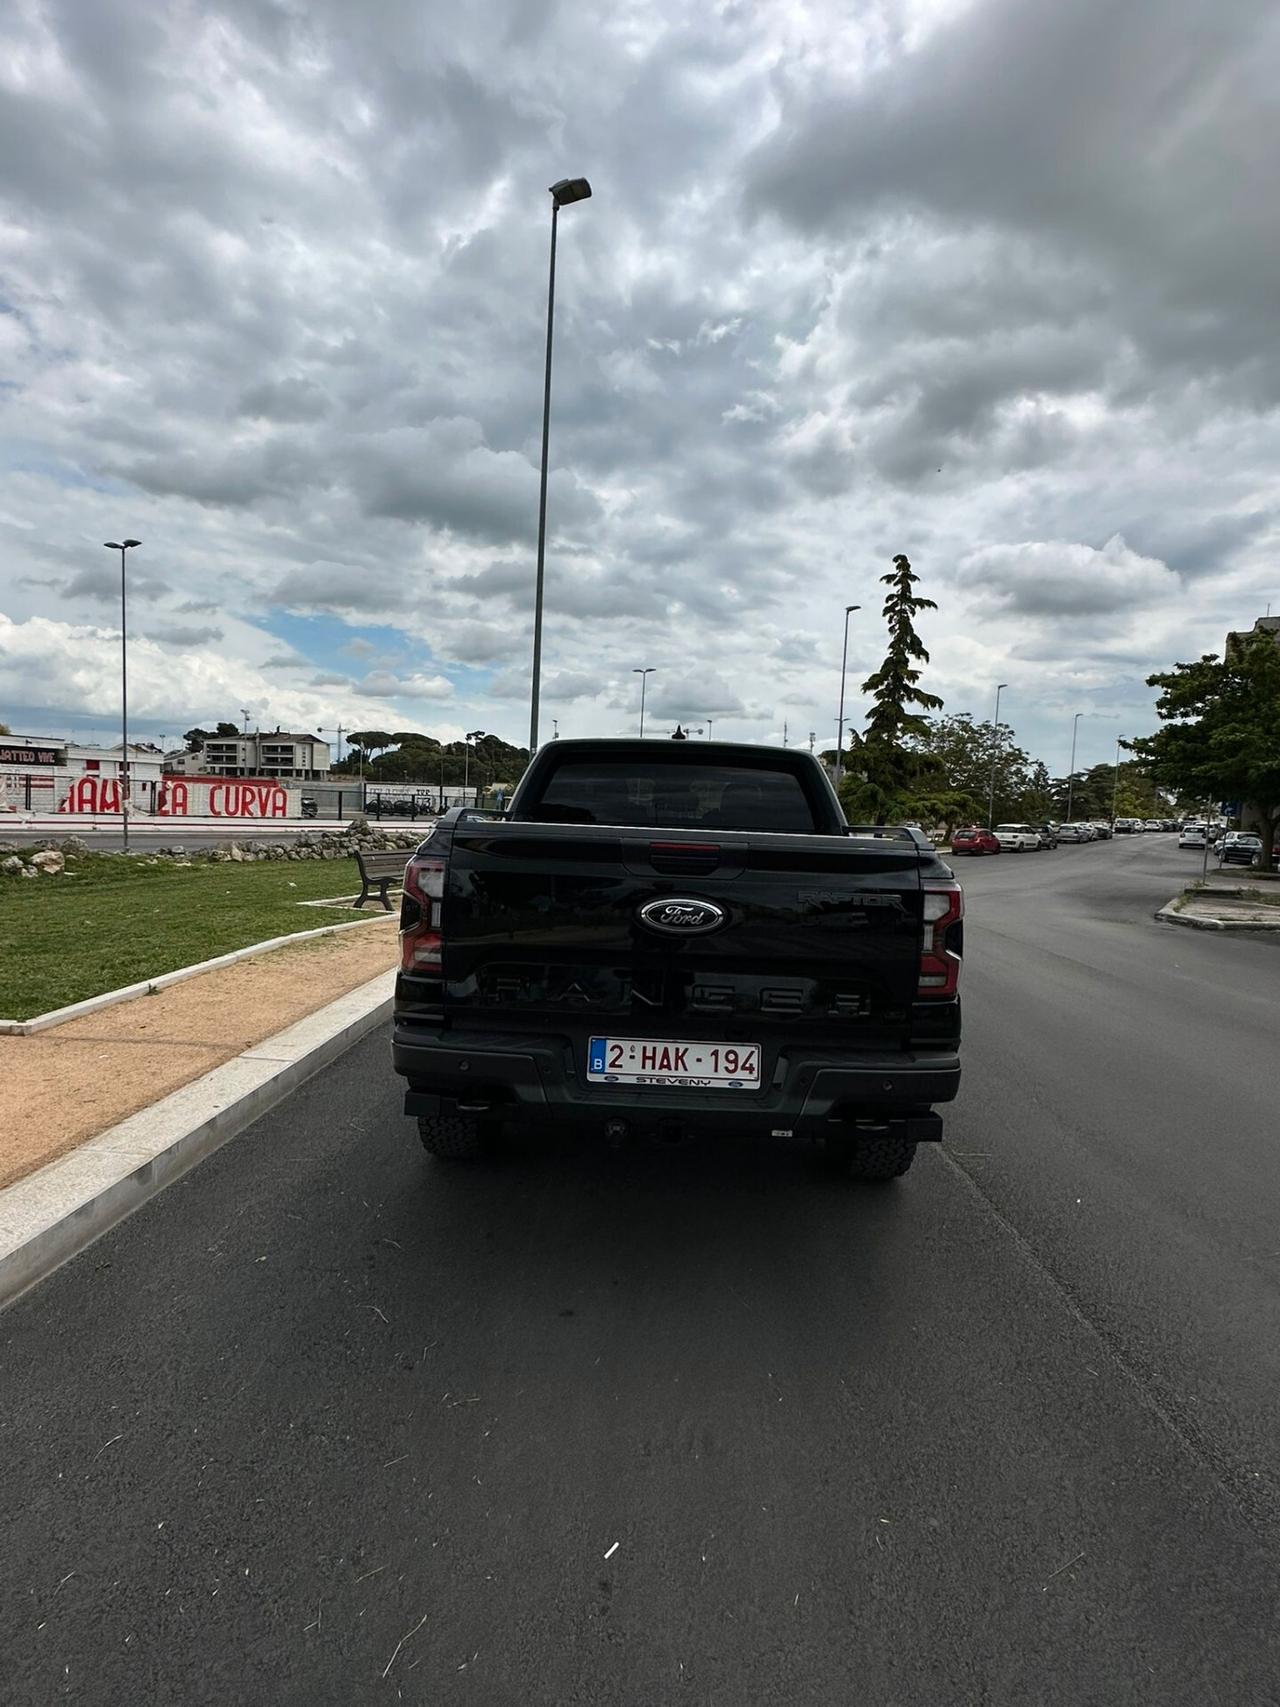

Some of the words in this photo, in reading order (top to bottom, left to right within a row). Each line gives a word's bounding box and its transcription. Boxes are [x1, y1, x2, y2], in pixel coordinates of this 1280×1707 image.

[209, 784, 288, 817] CURVA
[659, 905, 705, 925] Ford
[594, 1059, 603, 1070] B
[635, 1076, 711, 1087] STEVENY
